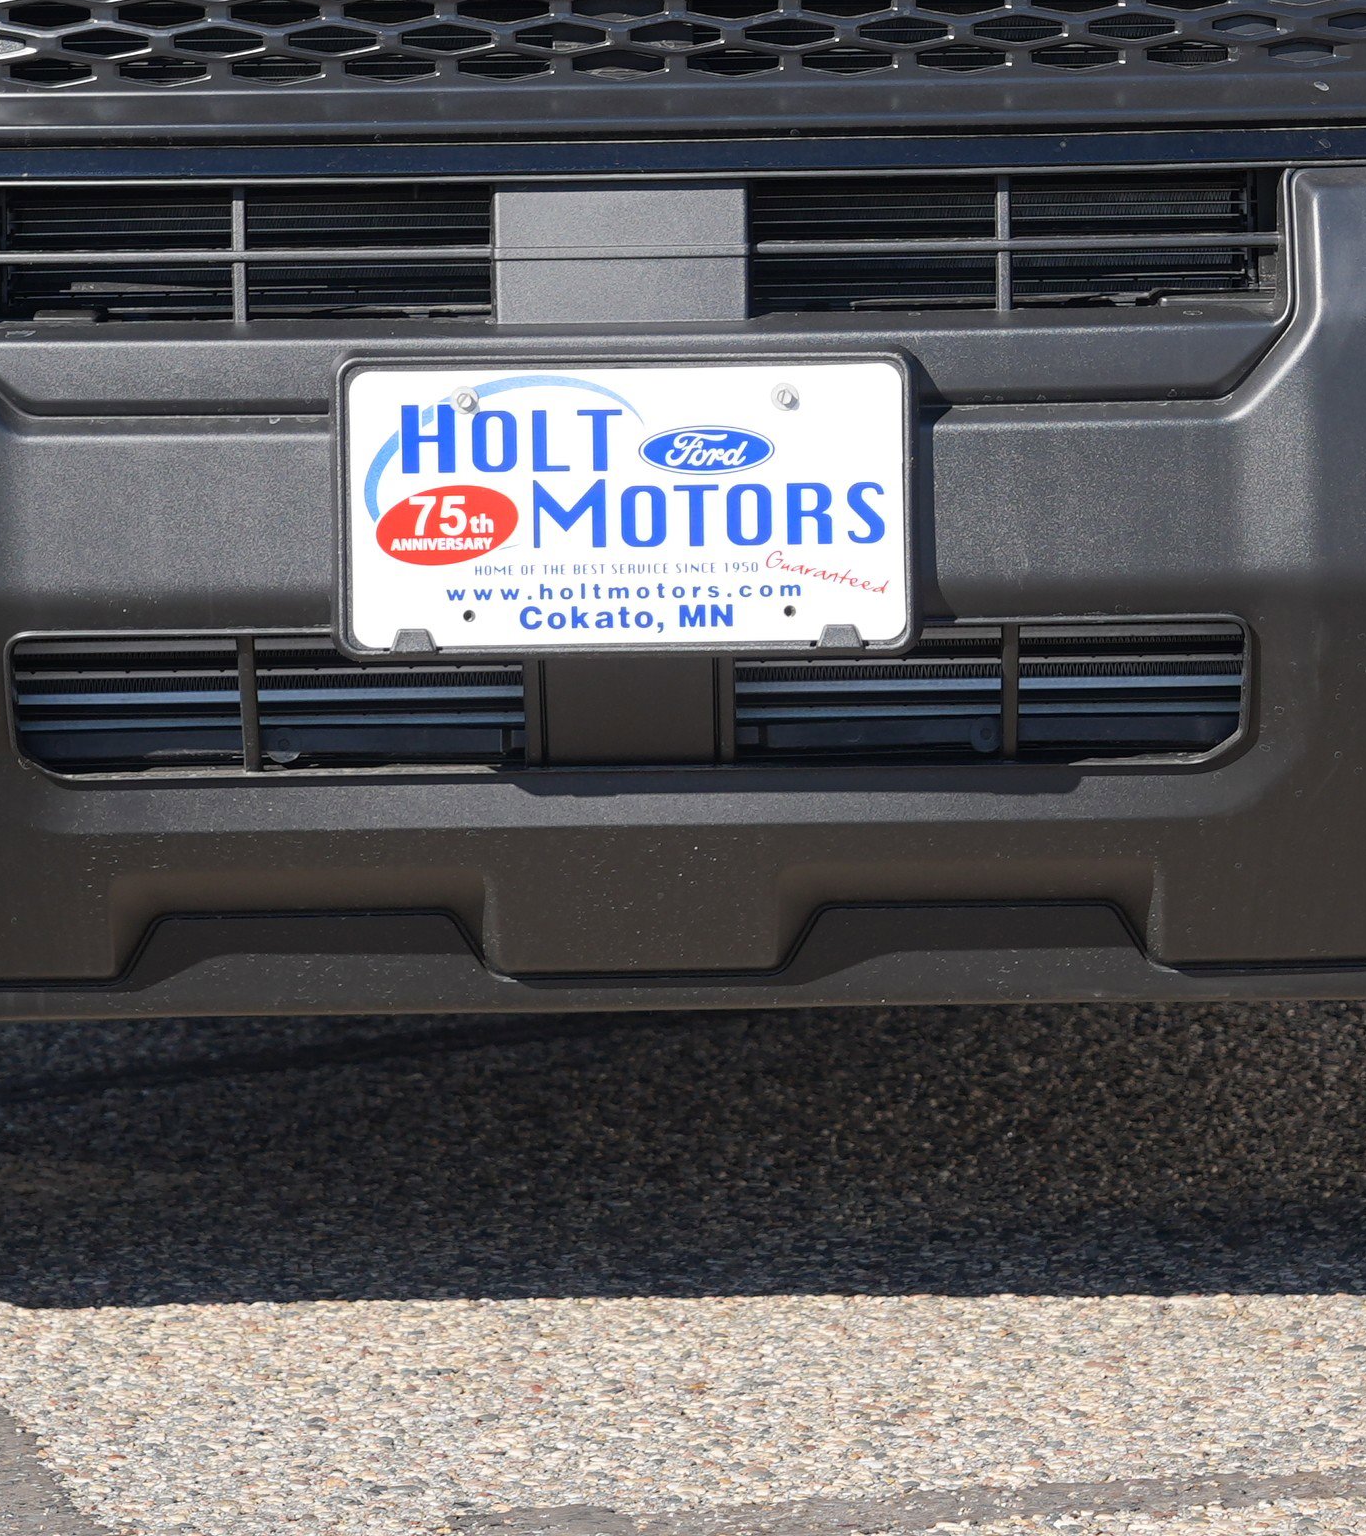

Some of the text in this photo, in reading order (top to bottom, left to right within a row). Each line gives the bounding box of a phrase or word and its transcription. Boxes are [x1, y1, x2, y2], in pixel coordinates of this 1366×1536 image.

[401, 404, 622, 474] HOLT
[665, 432, 749, 467] Ford
[408, 495, 494, 536] 75th
[533, 479, 885, 548] MOTORS
[390, 537, 494, 551] ANNIVERSARY
[474, 561, 760, 576] HOME OF THE BEST SERVICE SINCE 1950
[765, 550, 891, 594] Guaranteed
[446, 582, 802, 602] www.holtmotors.com
[519, 603, 734, 634] Cokato, MN
